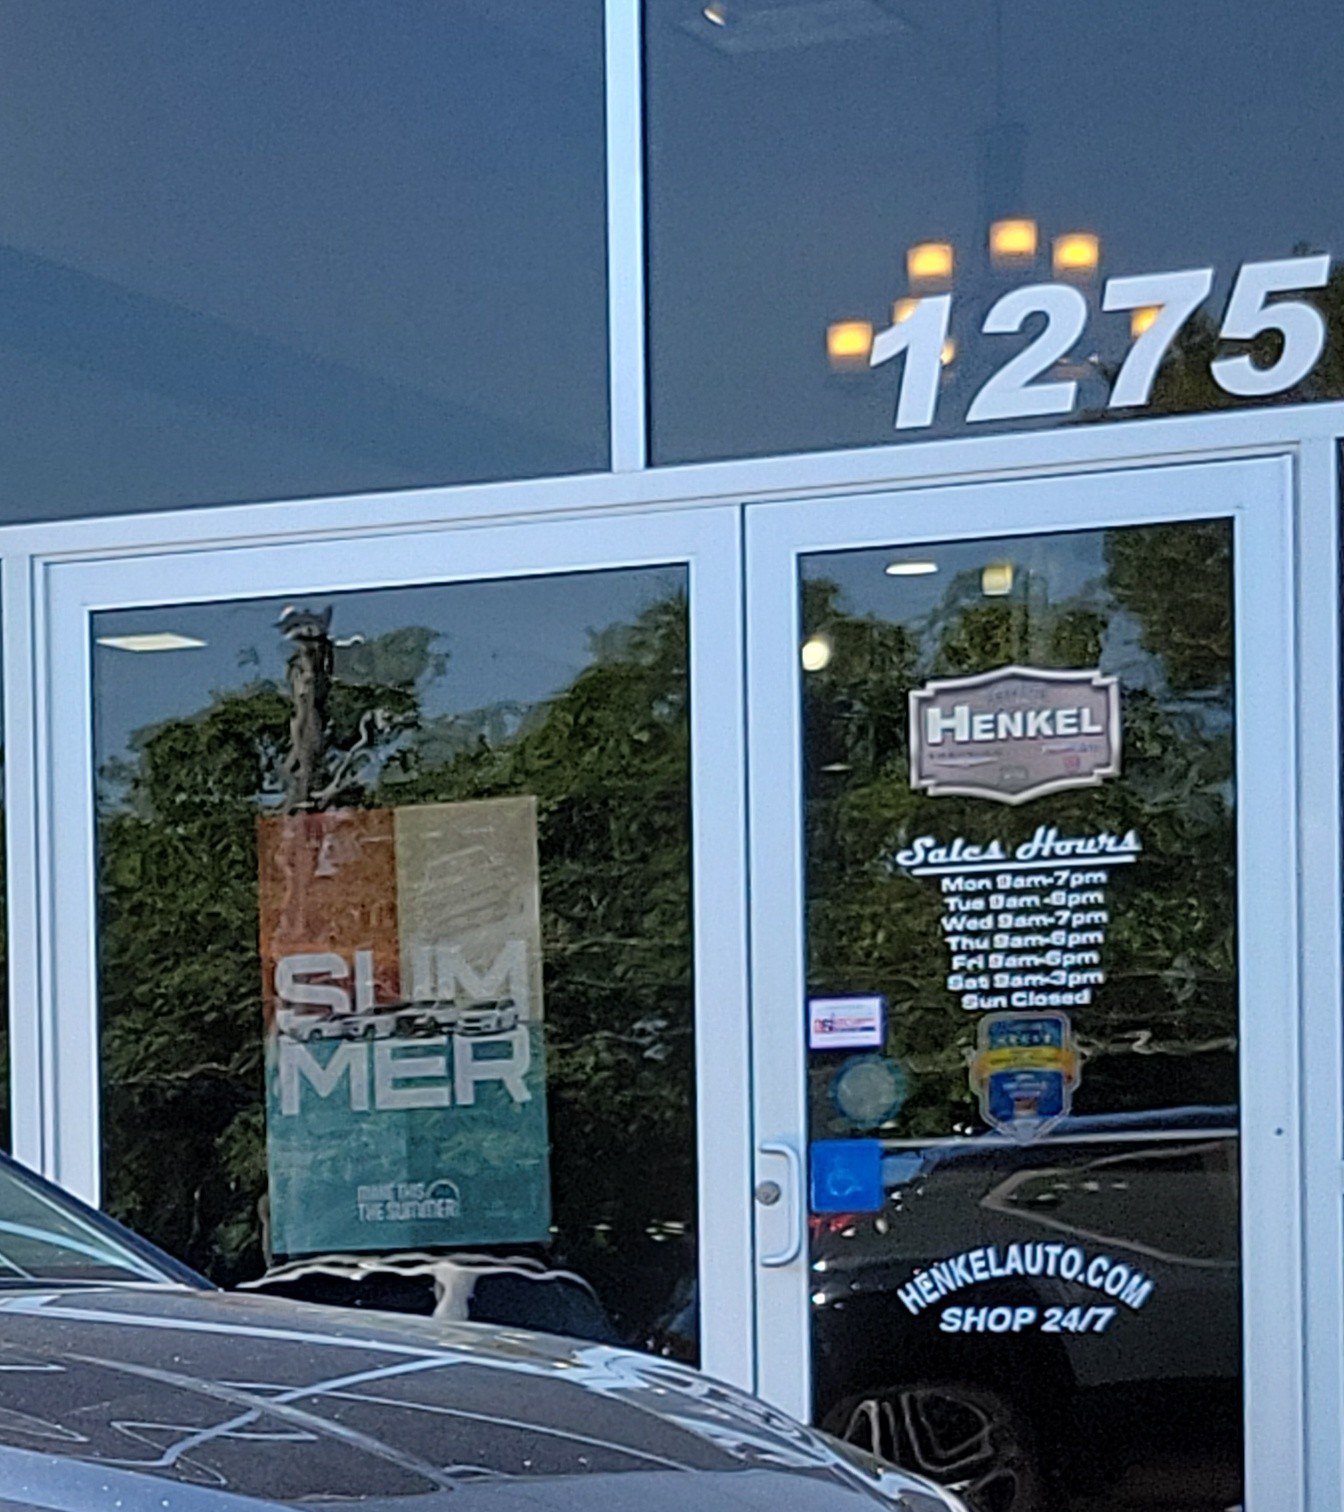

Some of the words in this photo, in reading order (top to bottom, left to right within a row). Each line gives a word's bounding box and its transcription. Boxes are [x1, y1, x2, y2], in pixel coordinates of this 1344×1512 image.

[869, 254, 1331, 429] 1275
[926, 705, 1104, 745] HENKEL
[896, 836, 1006, 866] Sales
[1015, 824, 1143, 861] Hours
[941, 876, 992, 893] Mon
[944, 896, 986, 912] Tue
[941, 914, 994, 931] Wed
[945, 936, 990, 951] Thu
[951, 954, 985, 970] Fri
[947, 974, 990, 991] Sat
[962, 992, 1008, 1010] Sun
[1011, 987, 1092, 1007] Closed
[278, 1025, 532, 1116] MER
[896, 1242, 1154, 1315] HENKELAUTO.COM
[939, 1306, 1037, 1333] SHOP
[1041, 1306, 1117, 1333] 24/7
